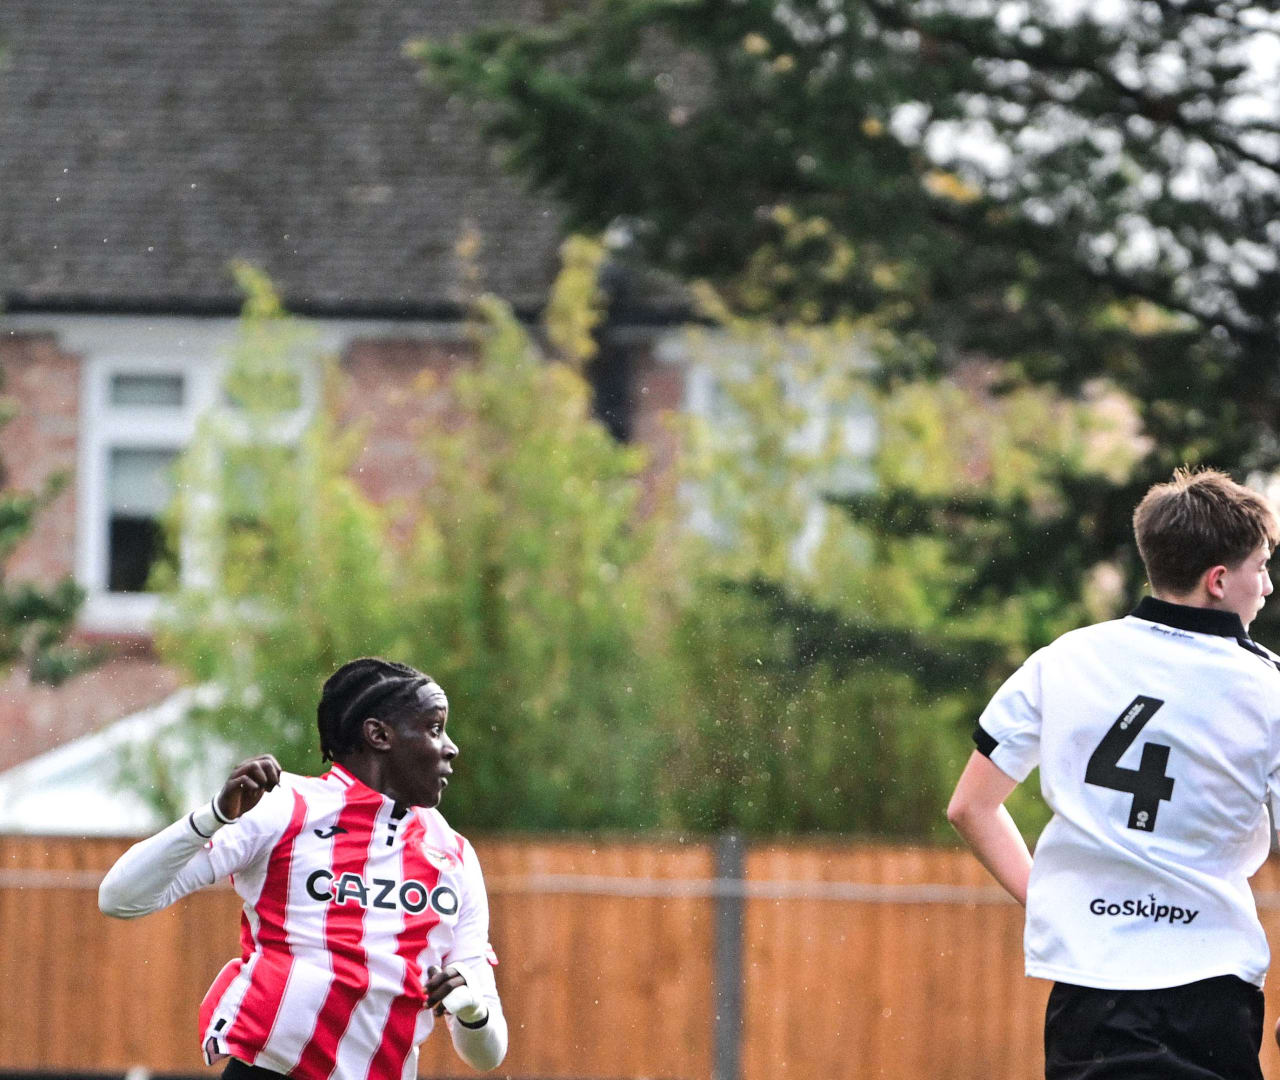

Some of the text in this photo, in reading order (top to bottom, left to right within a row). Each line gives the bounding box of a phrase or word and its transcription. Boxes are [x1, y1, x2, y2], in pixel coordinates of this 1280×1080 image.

[1085, 695, 1175, 833] 4
[306, 869, 459, 916] CAZOO
[1089, 895, 1199, 925] GoSkippy
